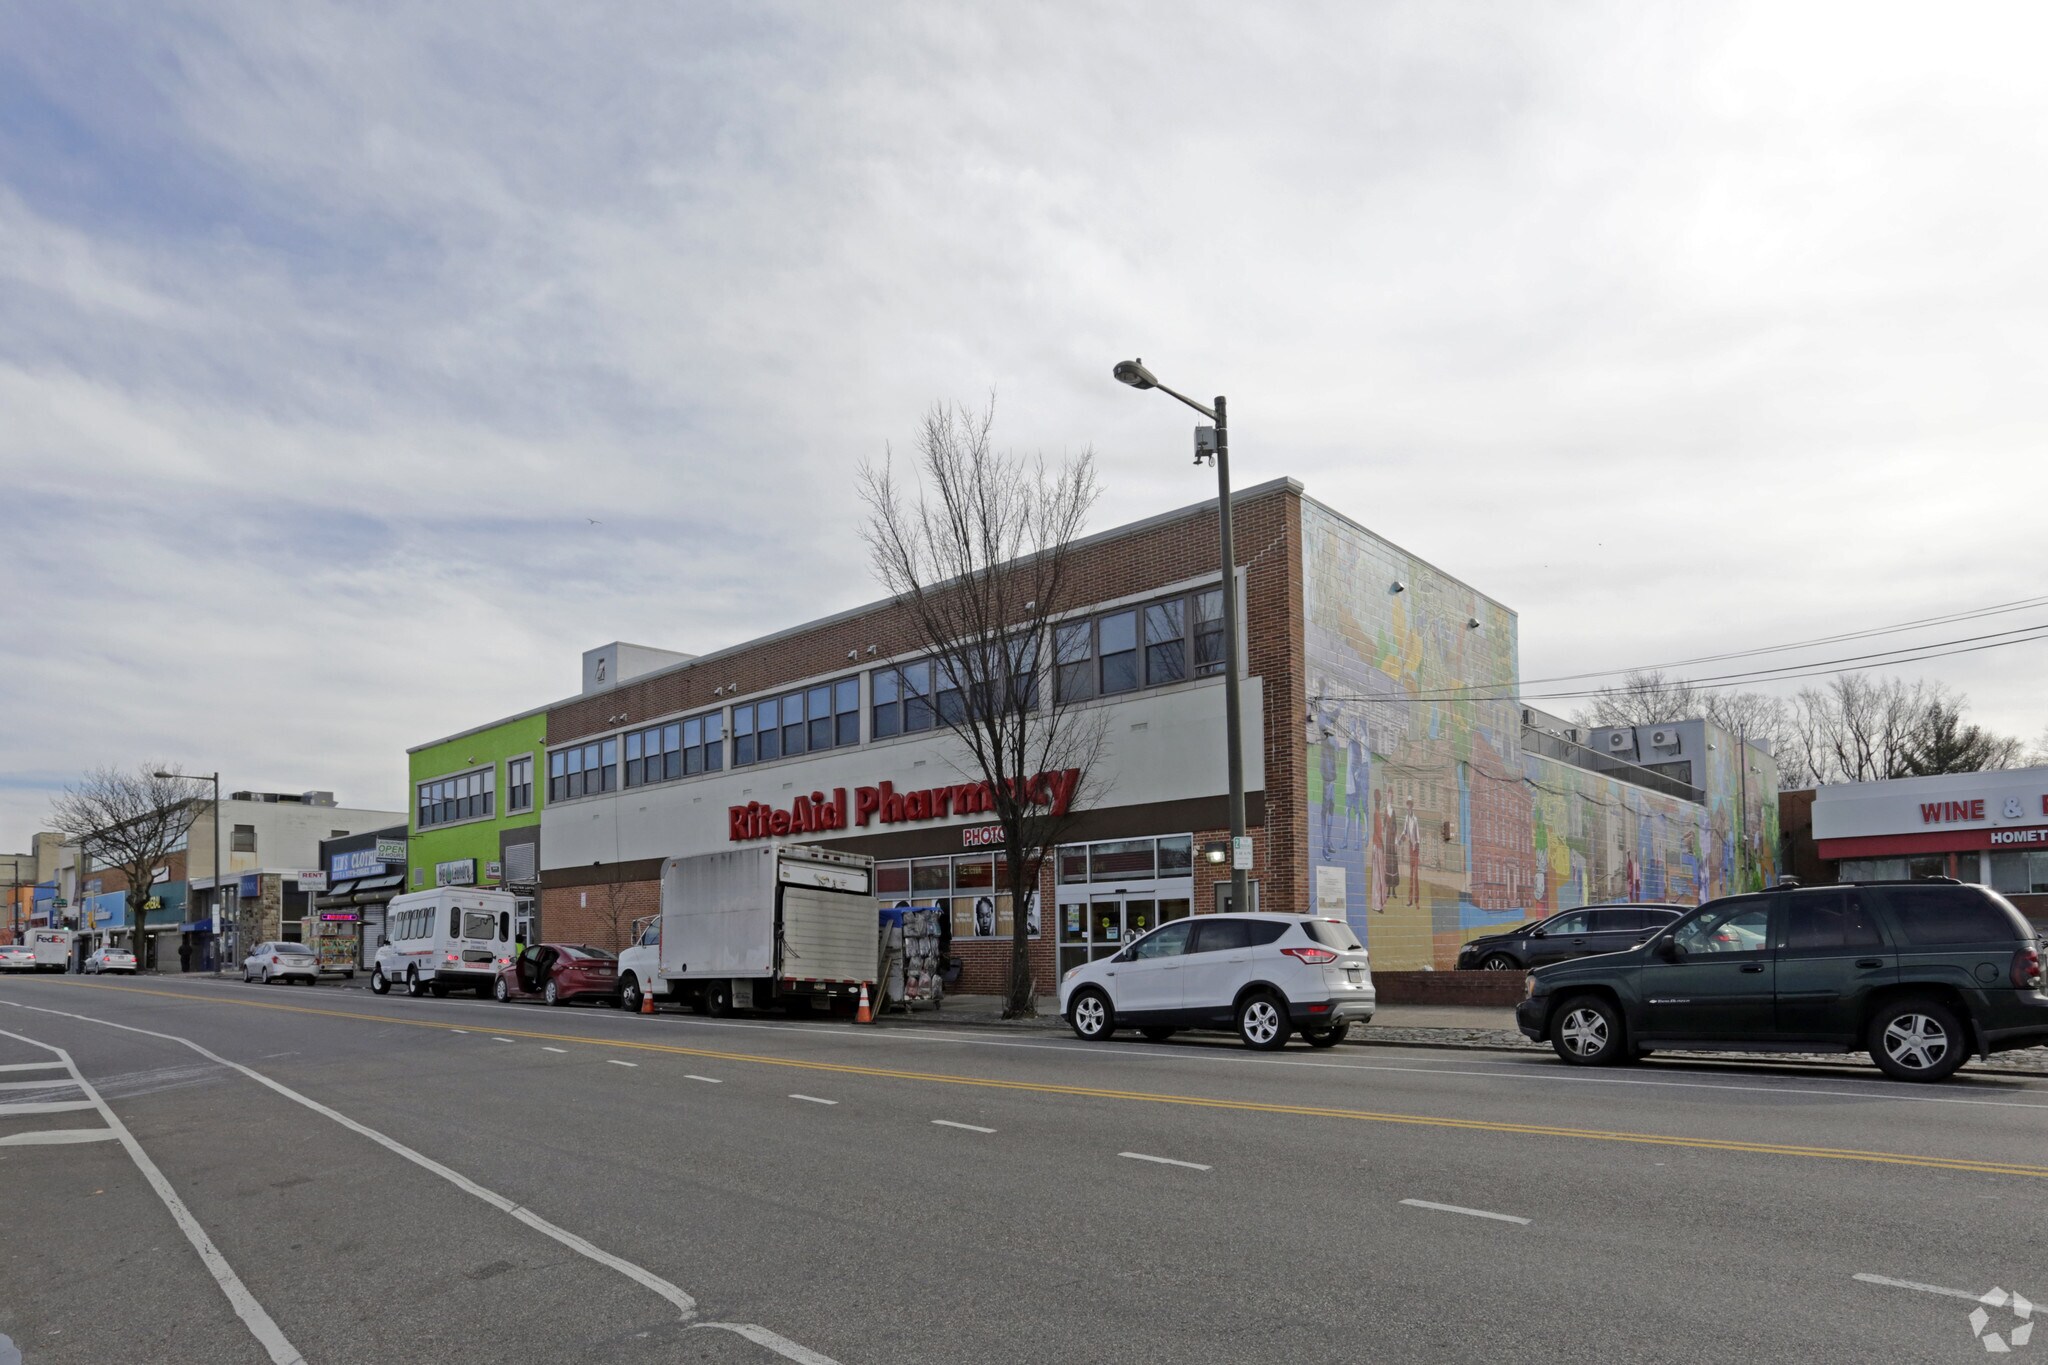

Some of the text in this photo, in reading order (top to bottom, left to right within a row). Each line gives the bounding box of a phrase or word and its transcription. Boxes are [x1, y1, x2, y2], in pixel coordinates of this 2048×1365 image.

[1920, 799, 1984, 824] WINE
[2003, 797, 2023, 818] &
[1991, 829, 2048, 844] HOMET
[379, 845, 404, 853] OPEN
[37, 934, 65, 943] FedEx
